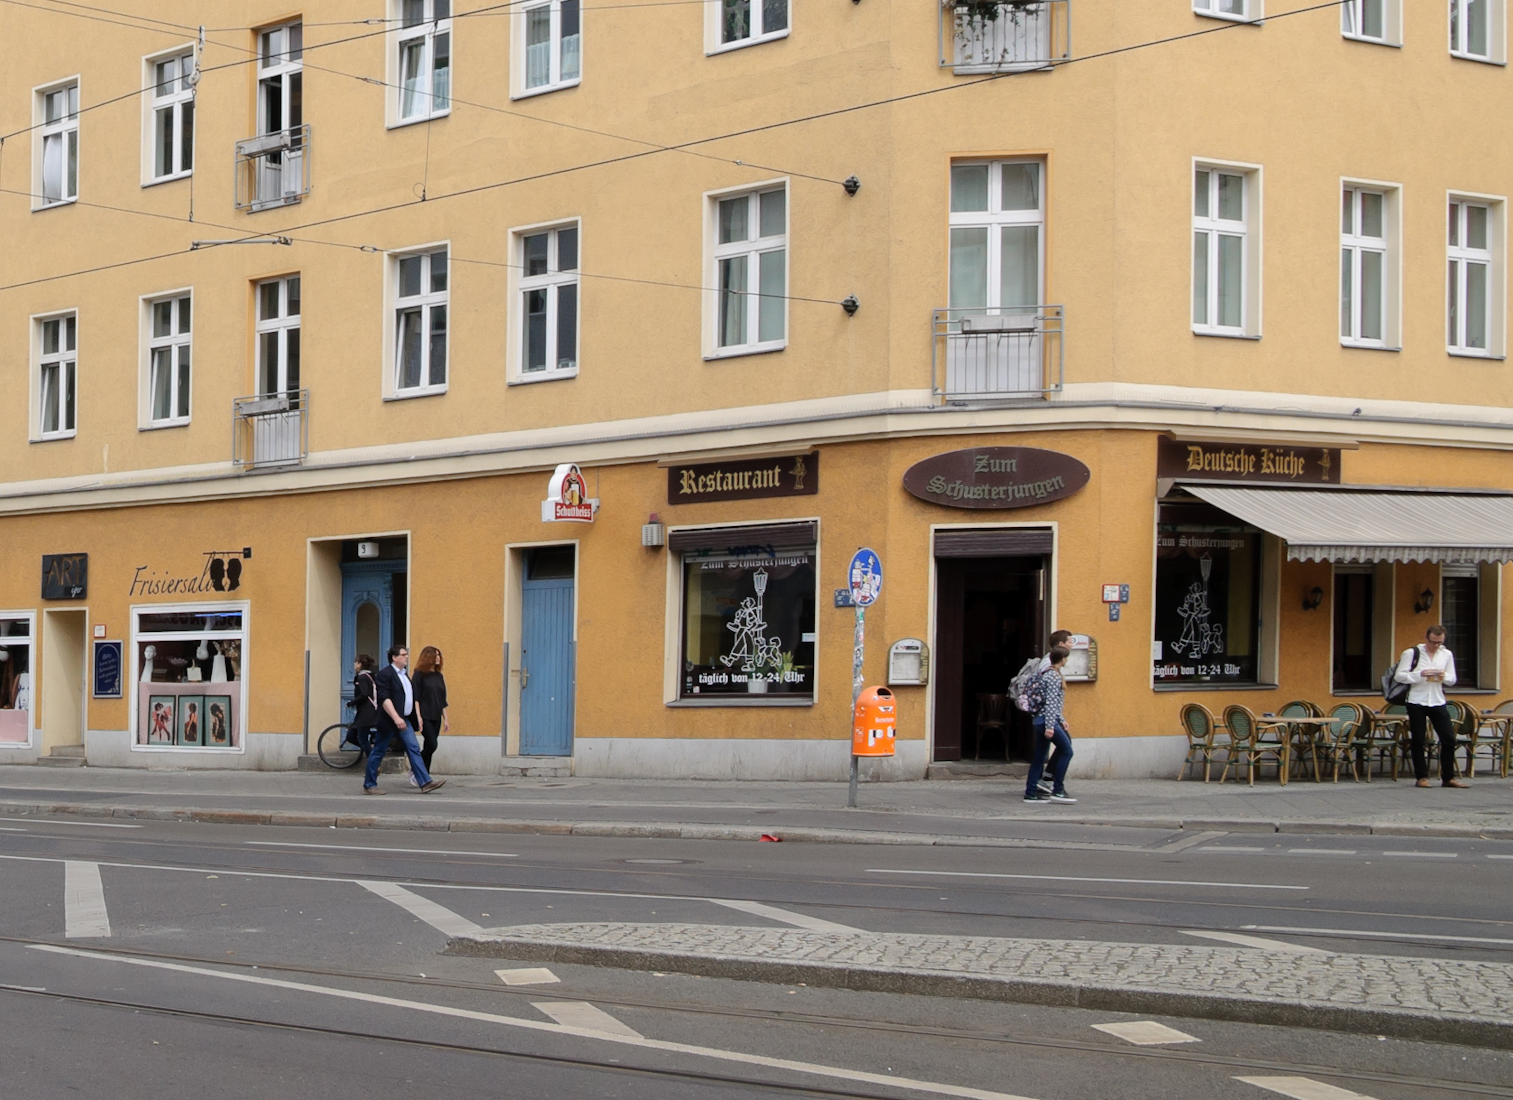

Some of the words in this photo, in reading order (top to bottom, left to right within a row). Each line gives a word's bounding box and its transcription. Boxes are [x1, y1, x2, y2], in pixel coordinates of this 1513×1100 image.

[974, 454, 1017, 473] Zum
[1187, 444, 1256, 476] Deutsche
[1260, 448, 1305, 478] Küche
[679, 465, 781, 494] Restaurant
[926, 474, 1065, 501] Schusterjungen
[556, 504, 591, 518] Schultheiss
[361, 544, 366, 554] 9
[1178, 535, 1245, 549] Schusterjungen
[44, 556, 85, 586] ART
[129, 553, 226, 596] Frisiersalo
[698, 672, 729, 685] täglich
[731, 673, 748, 683] von
[751, 672, 781, 683] 12-24
[784, 671, 805, 684] Uhr
[1153, 665, 1178, 677] täglich
[1180, 665, 1195, 675] von
[1198, 665, 1221, 675] 12-24
[1224, 663, 1241, 676] Uhr
